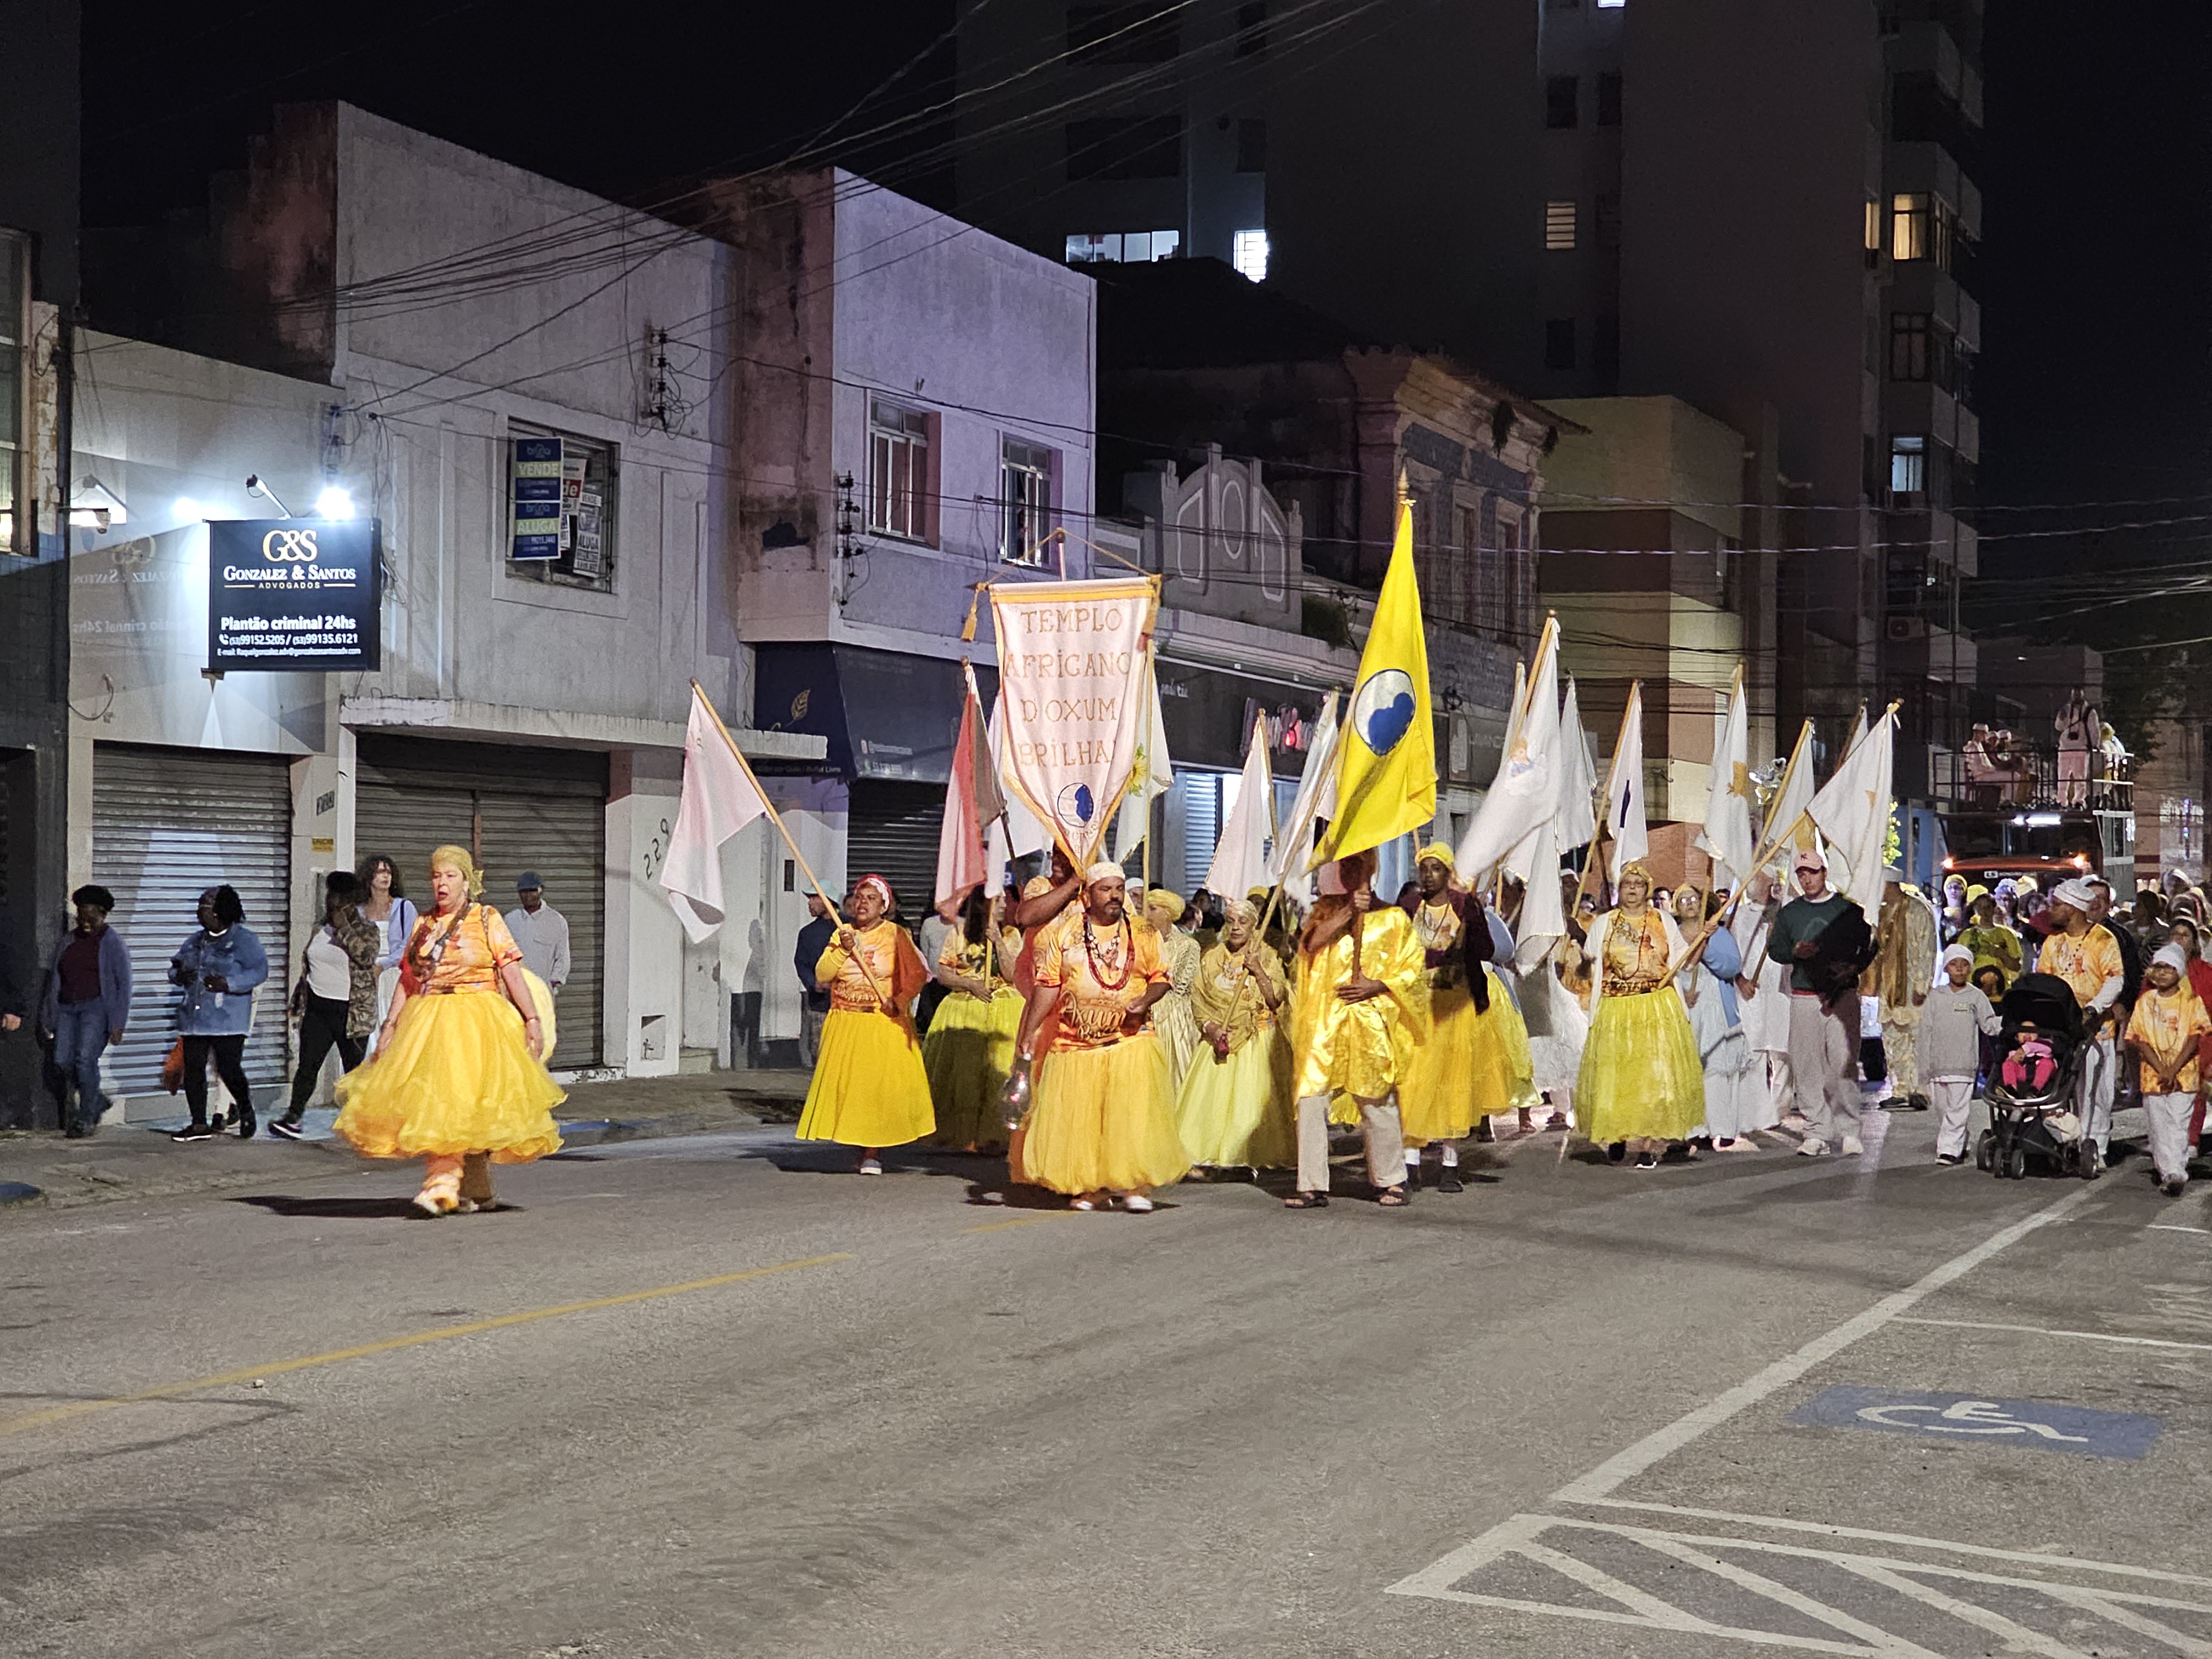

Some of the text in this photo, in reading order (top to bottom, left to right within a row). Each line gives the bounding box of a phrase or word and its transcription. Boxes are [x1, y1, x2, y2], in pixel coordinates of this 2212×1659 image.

[519, 463, 559, 475] VENDE
[517, 520, 556, 534] ALUGA
[263, 530, 317, 561] G&S
[223, 564, 356, 580] GONZALEZ & SANTOS
[221, 615, 356, 630] Plantão criminal 24hs
[1020, 608, 1121, 633] TEMPLO
[1004, 649, 1130, 678] AFRICANO
[1018, 738, 1116, 767] BRILHA
